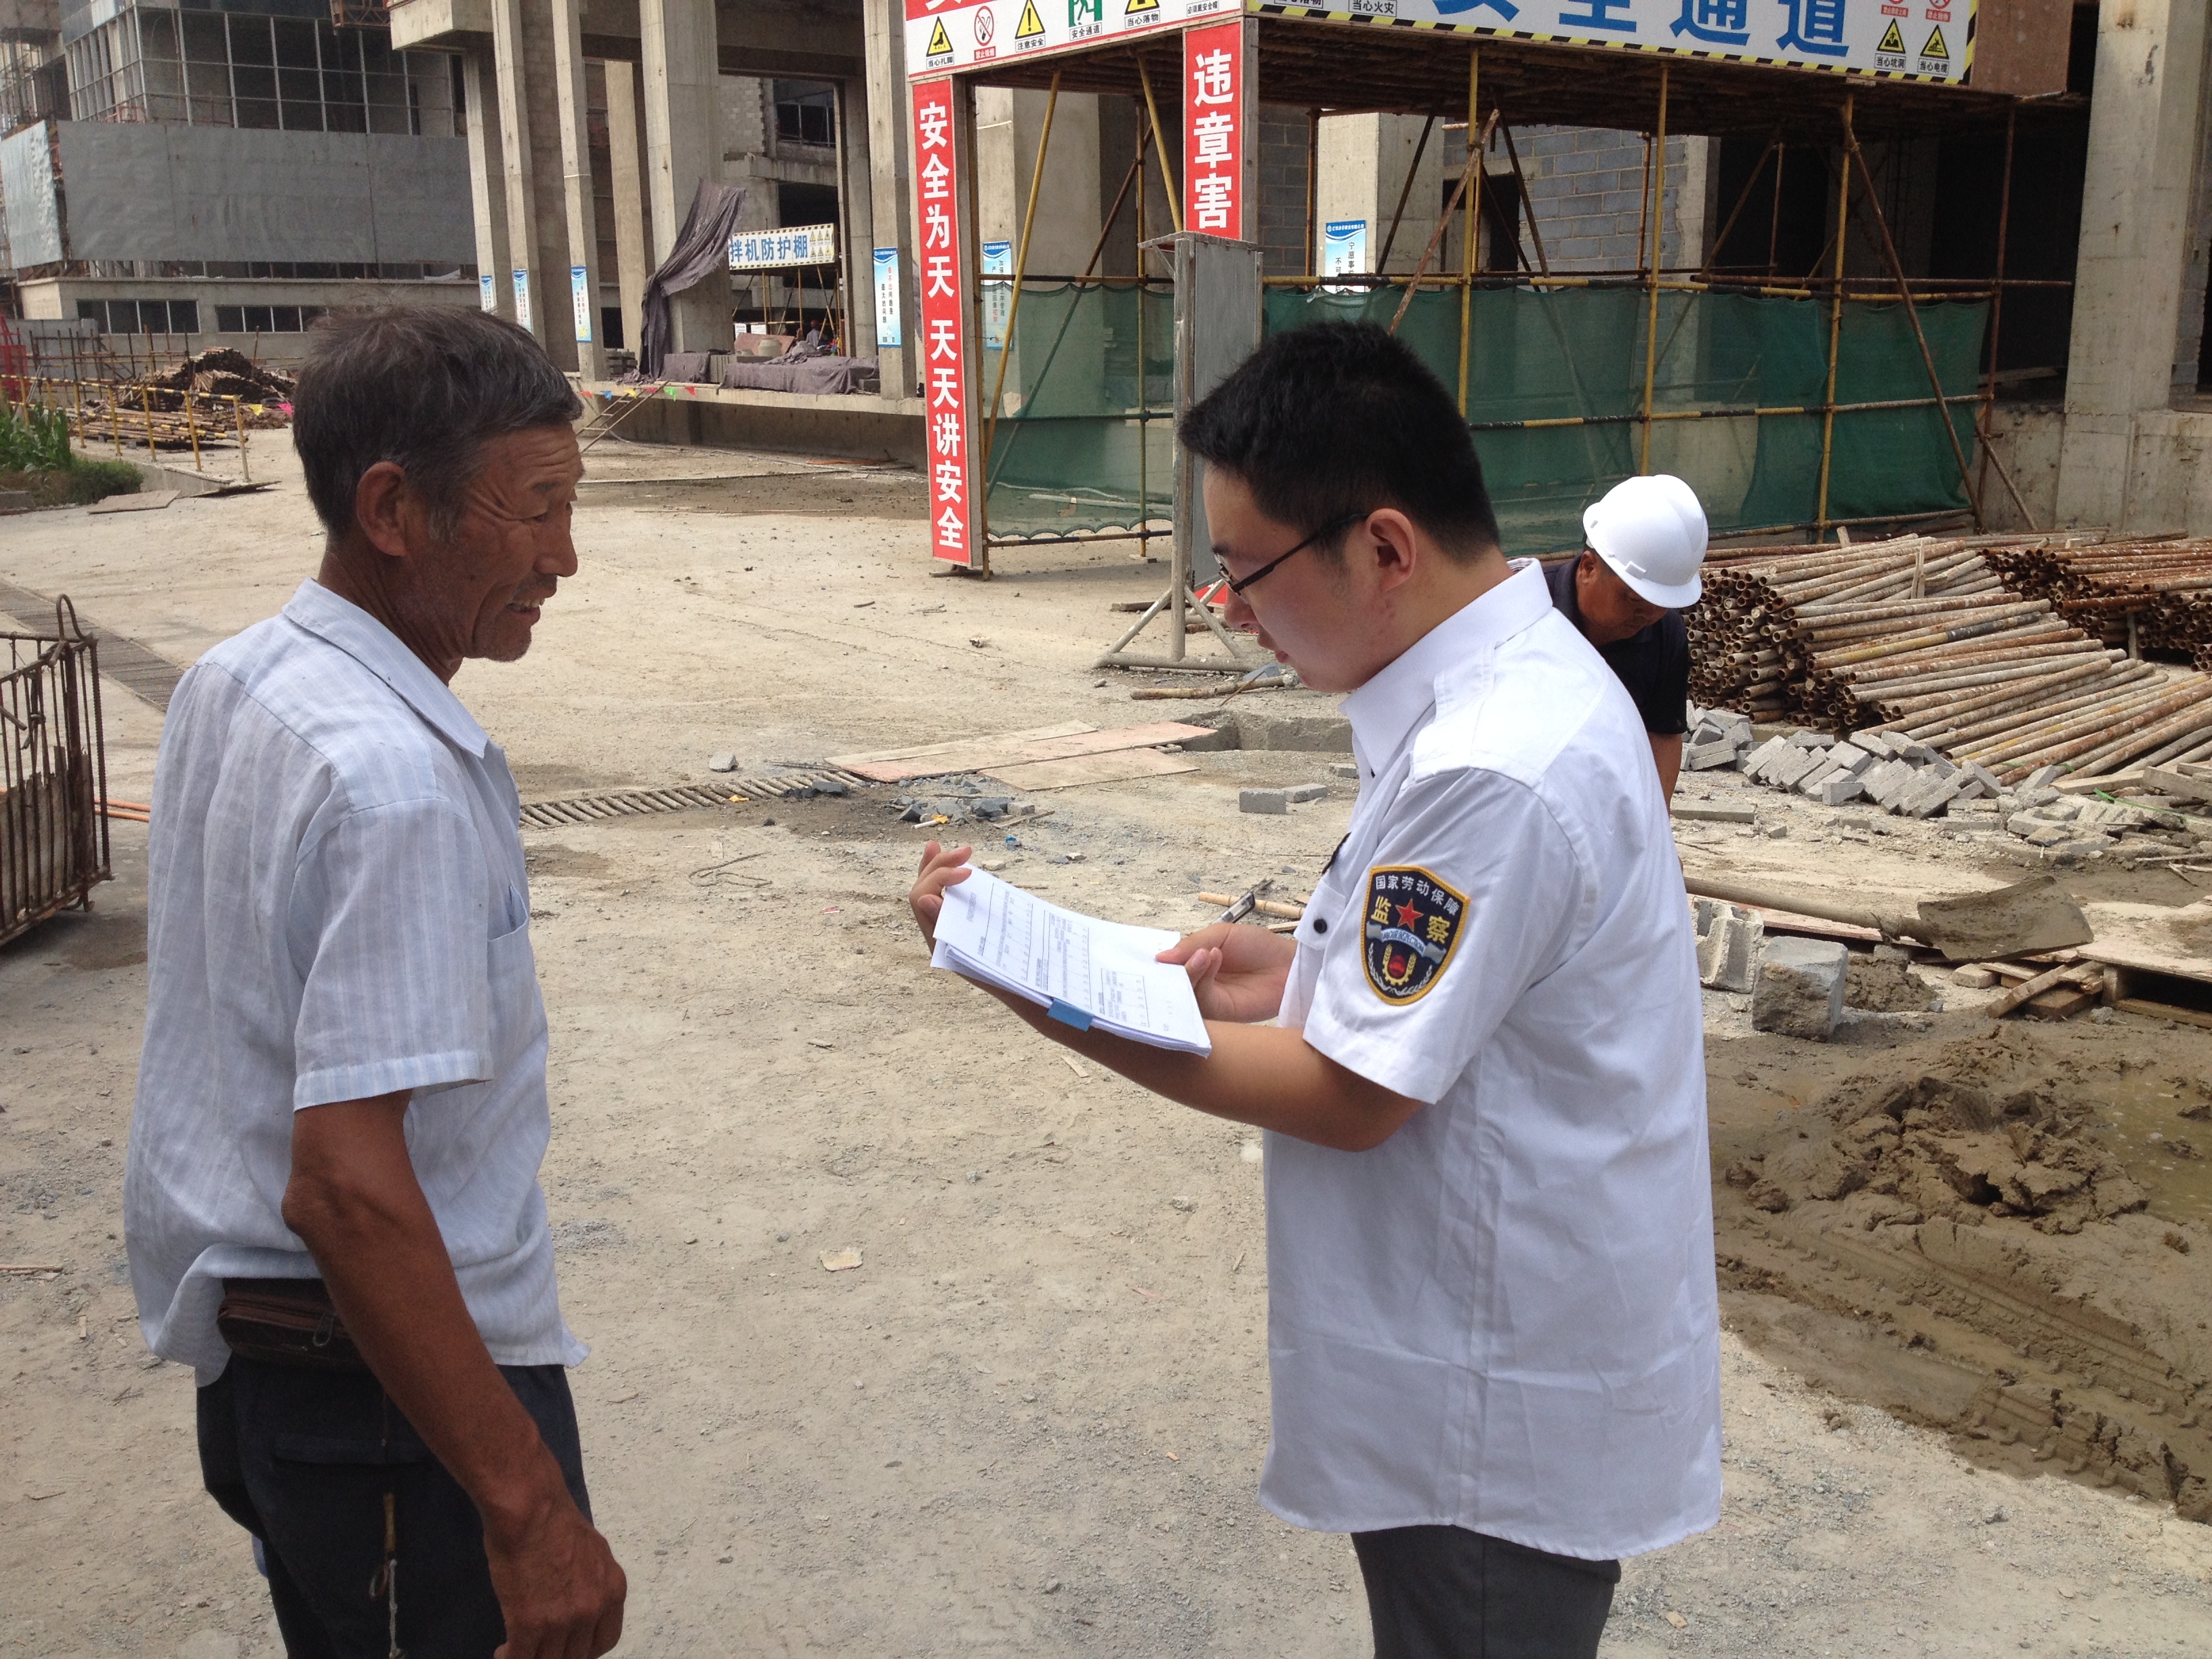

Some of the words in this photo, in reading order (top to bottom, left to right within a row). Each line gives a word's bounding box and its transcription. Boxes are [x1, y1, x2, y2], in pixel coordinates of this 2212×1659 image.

[1353, 0, 1395, 14] 当心火灾
[1127, 13, 1159, 26] 当心落物
[1071, 24, 1101, 39] 安全通道
[1017, 38, 1044, 50] 注意安全
[1877, 56, 1905, 68] 当心坑洞
[1919, 60, 1948, 73] 当心电缆
[1193, 49, 1233, 228] 违章害
[919, 102, 956, 299] 安全为天
[730, 234, 808, 262] 拌机防护棚
[930, 320, 963, 550] 天天讲安全
[1375, 874, 1460, 916] 国家劳动保障
